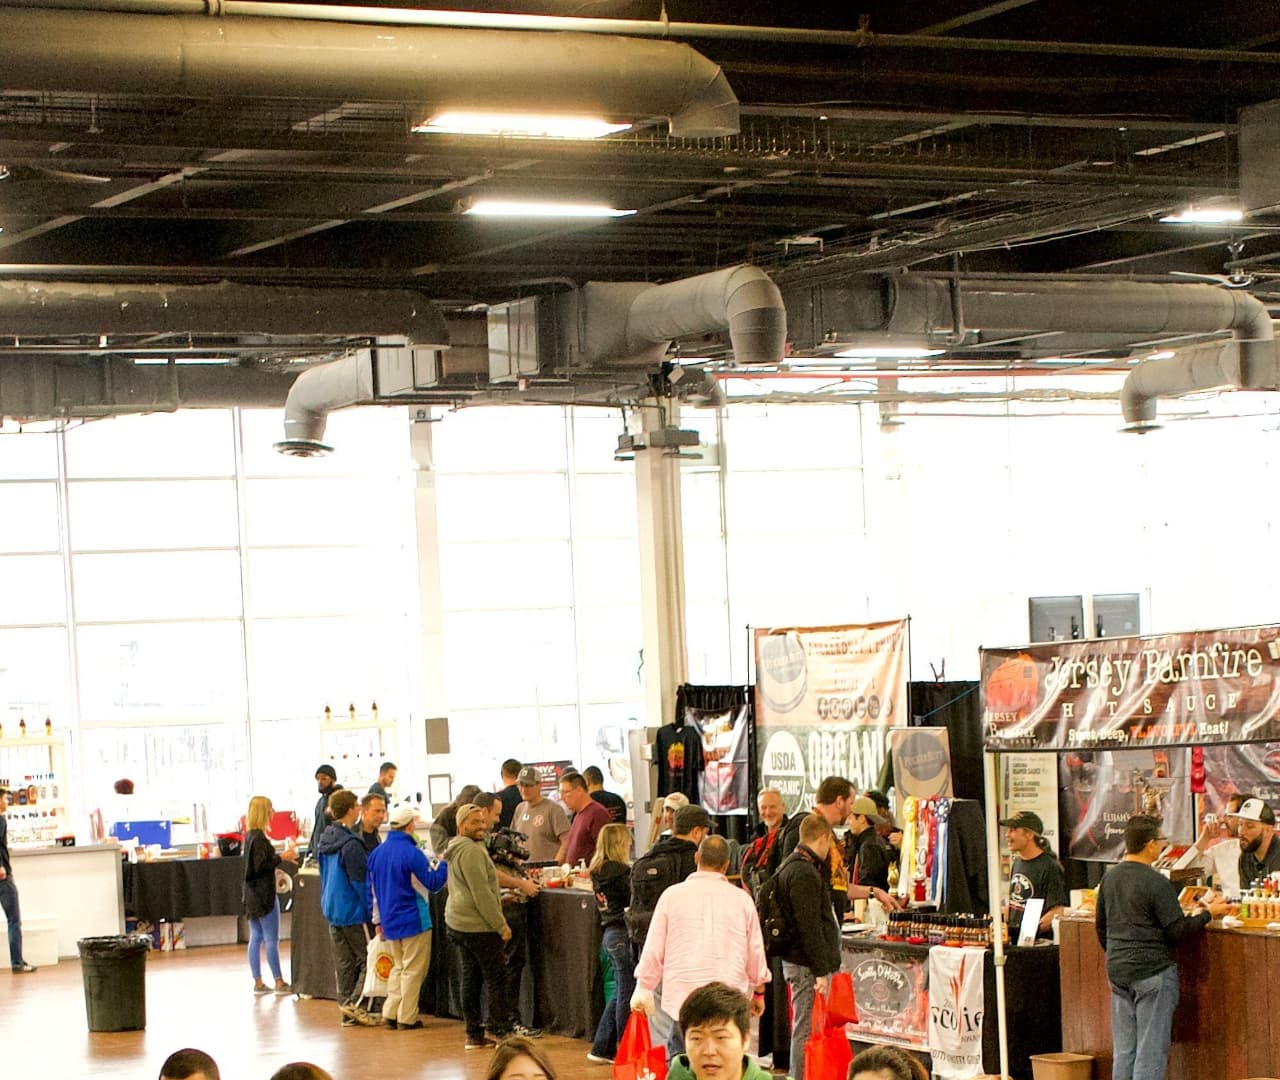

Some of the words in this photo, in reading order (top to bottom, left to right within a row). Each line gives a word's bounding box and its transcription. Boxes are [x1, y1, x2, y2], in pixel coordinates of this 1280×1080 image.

[1044, 655, 1131, 697] Jersey
[1143, 643, 1264, 686] Barnfire
[1144, 692, 1238, 715] SAUCE
[771, 751, 797, 771] USDA
